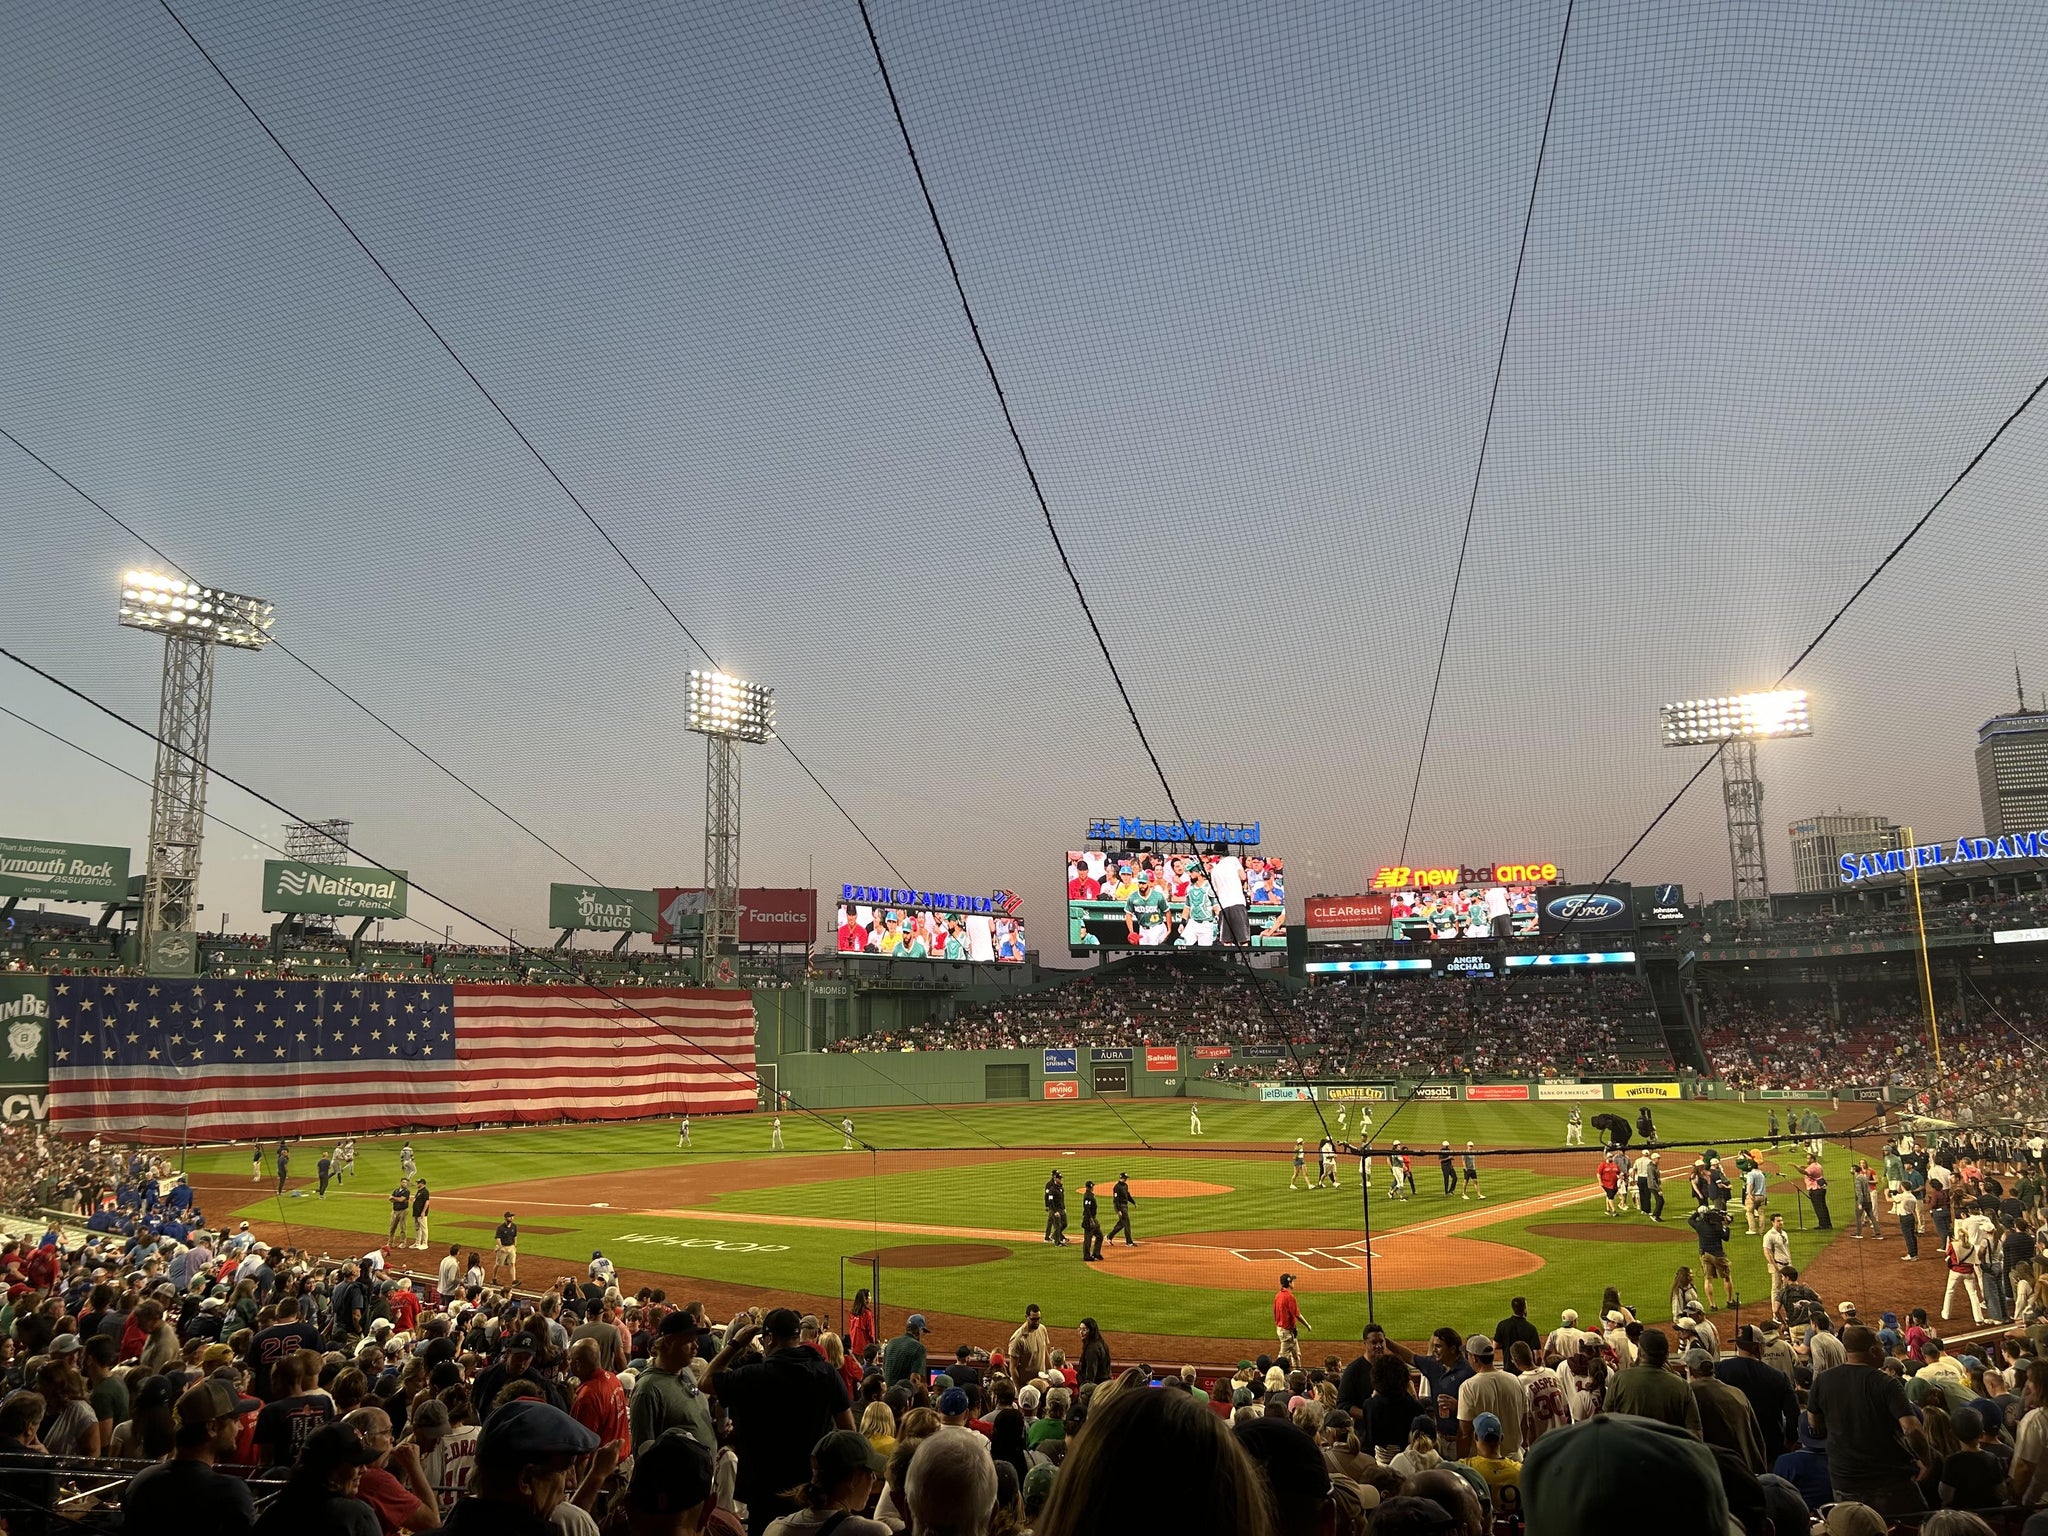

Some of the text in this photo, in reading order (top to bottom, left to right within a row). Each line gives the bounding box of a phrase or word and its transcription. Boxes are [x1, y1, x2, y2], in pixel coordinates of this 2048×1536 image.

[1118, 816, 1260, 844] MassMutual
[17, 845, 31, 853] Just
[69, 859, 113, 878] Rock
[1839, 844, 1949, 883] SAMUEL
[1414, 867, 1459, 886] new
[1460, 862, 1557, 884] balance
[306, 874, 396, 899] National
[338, 898, 391, 910] Car Rental
[843, 883, 993, 912] BANK OF AMERICA
[578, 901, 633, 917] DRAFT
[1314, 904, 1382, 917] CLEAResult
[1562, 897, 1609, 917] Ford
[584, 914, 631, 928] KINGS
[750, 909, 807, 923] Fanatics
[1658, 912, 1684, 920] Controls
[1447, 962, 1491, 971] ORCHARD
[1452, 956, 1484, 964] ANGRY
[814, 986, 847, 995] ABIOMED
[1050, 1086, 1073, 1094] IRVING
[1264, 1088, 1293, 1099] jetBlue
[1329, 1086, 1384, 1099] GRANITE CITY
[1416, 1086, 1451, 1096] wasabi
[1626, 1087, 1668, 1096] TWISTED TEA
[611, 1234, 791, 1252] WHOOP
[1533, 1391, 1564, 1420] 30
